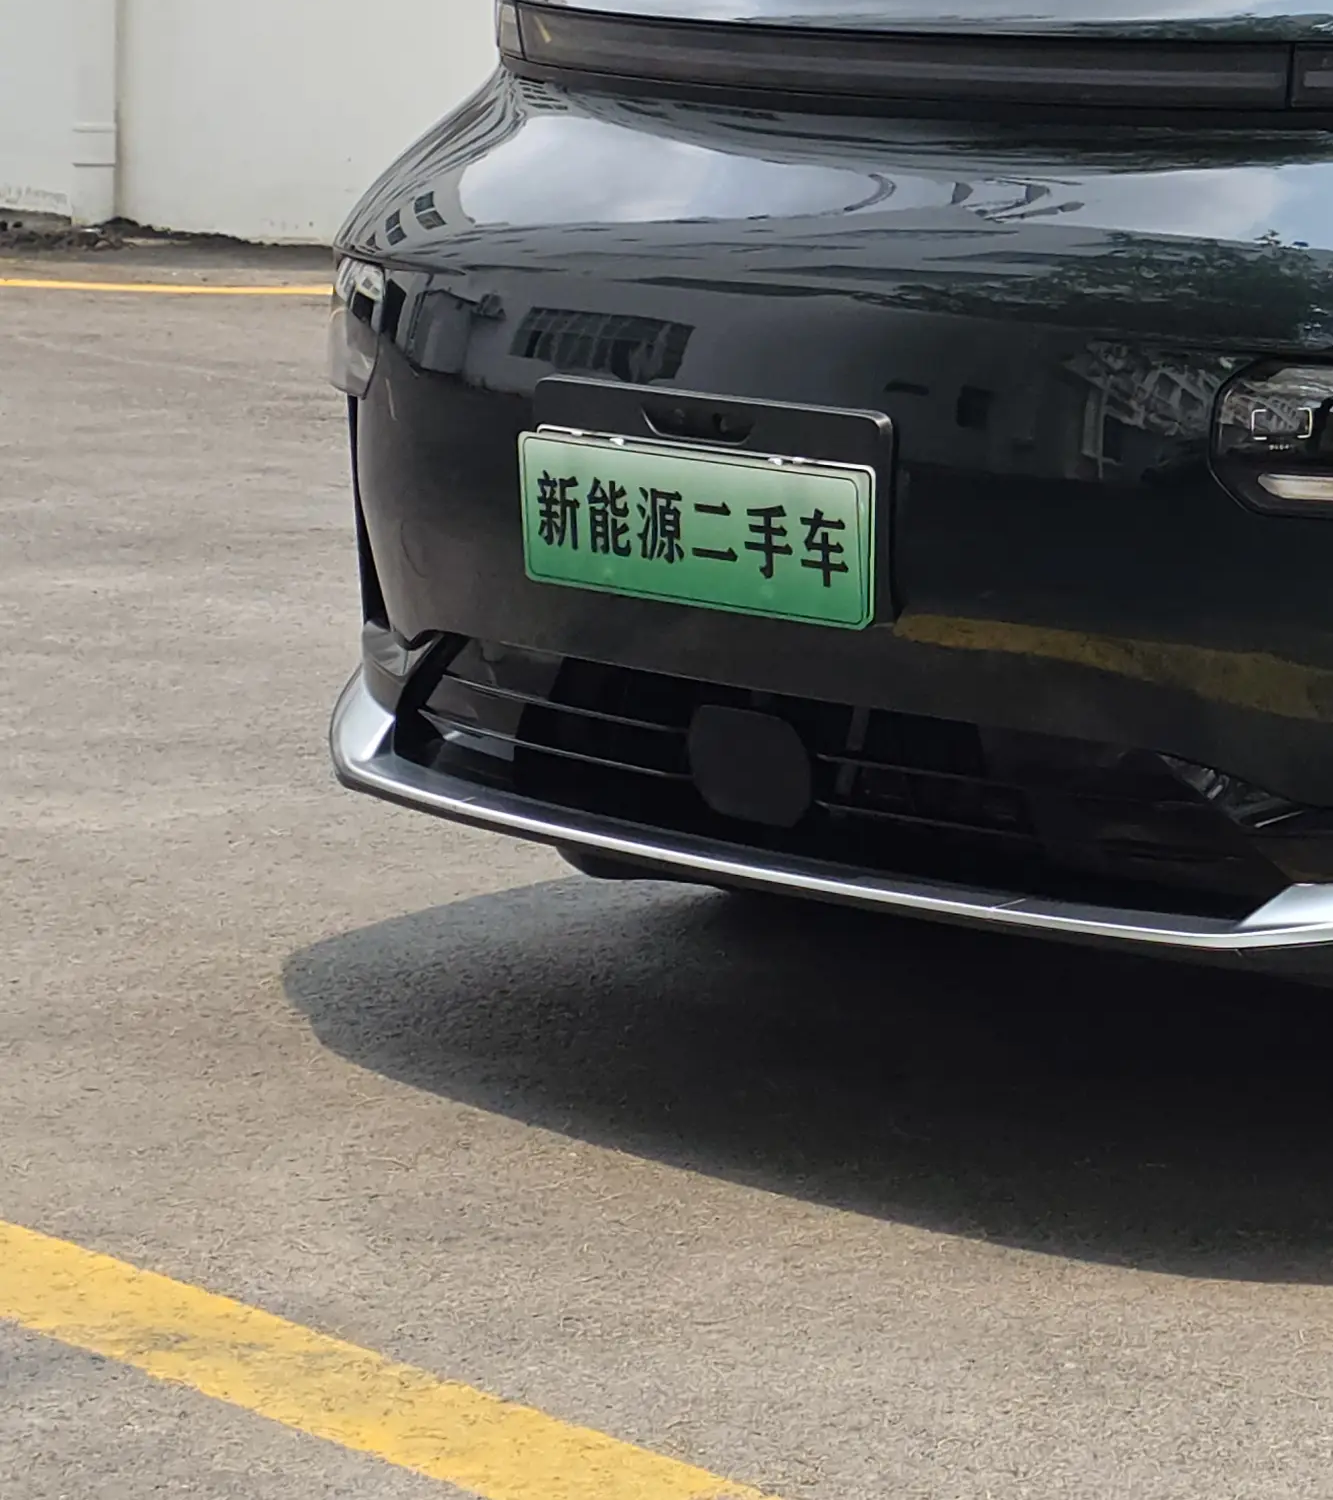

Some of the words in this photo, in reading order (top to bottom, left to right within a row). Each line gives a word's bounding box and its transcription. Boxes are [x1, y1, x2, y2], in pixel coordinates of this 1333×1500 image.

[537, 470, 850, 589] 新能源二手车
